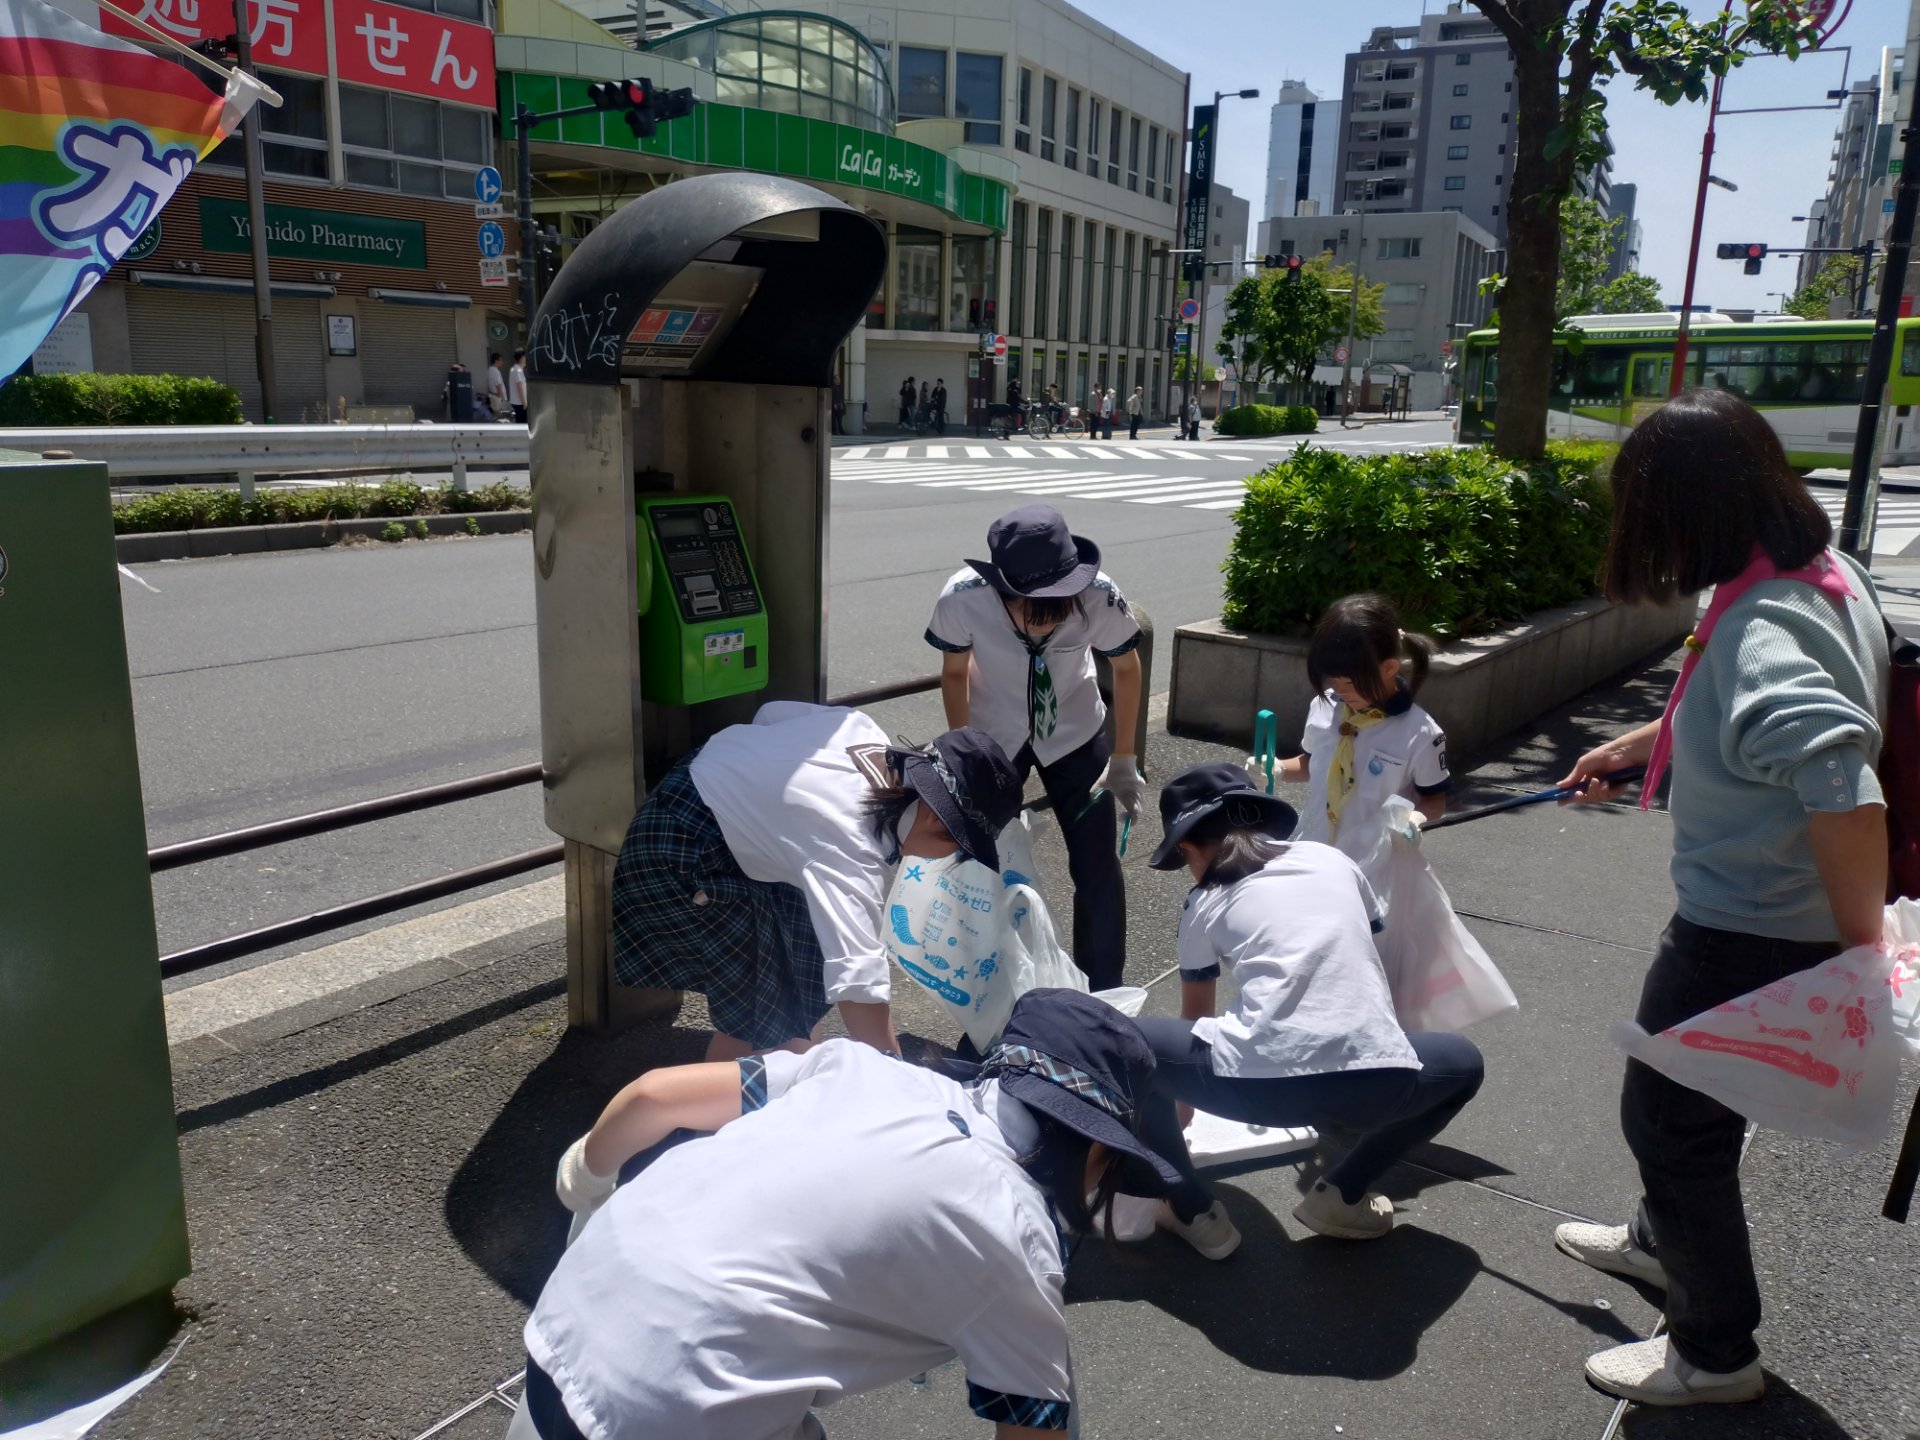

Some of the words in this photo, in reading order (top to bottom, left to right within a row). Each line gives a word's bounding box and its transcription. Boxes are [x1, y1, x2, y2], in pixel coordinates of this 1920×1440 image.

[840, 144, 883, 178] LaLa
[888, 163, 921, 188] ガーデン
[1196, 140, 1206, 180] SMBC
[311, 224, 406, 259] Pharmacy
[484, 232, 494, 254] P
[935, 875, 992, 913] 海ごみゼロ
